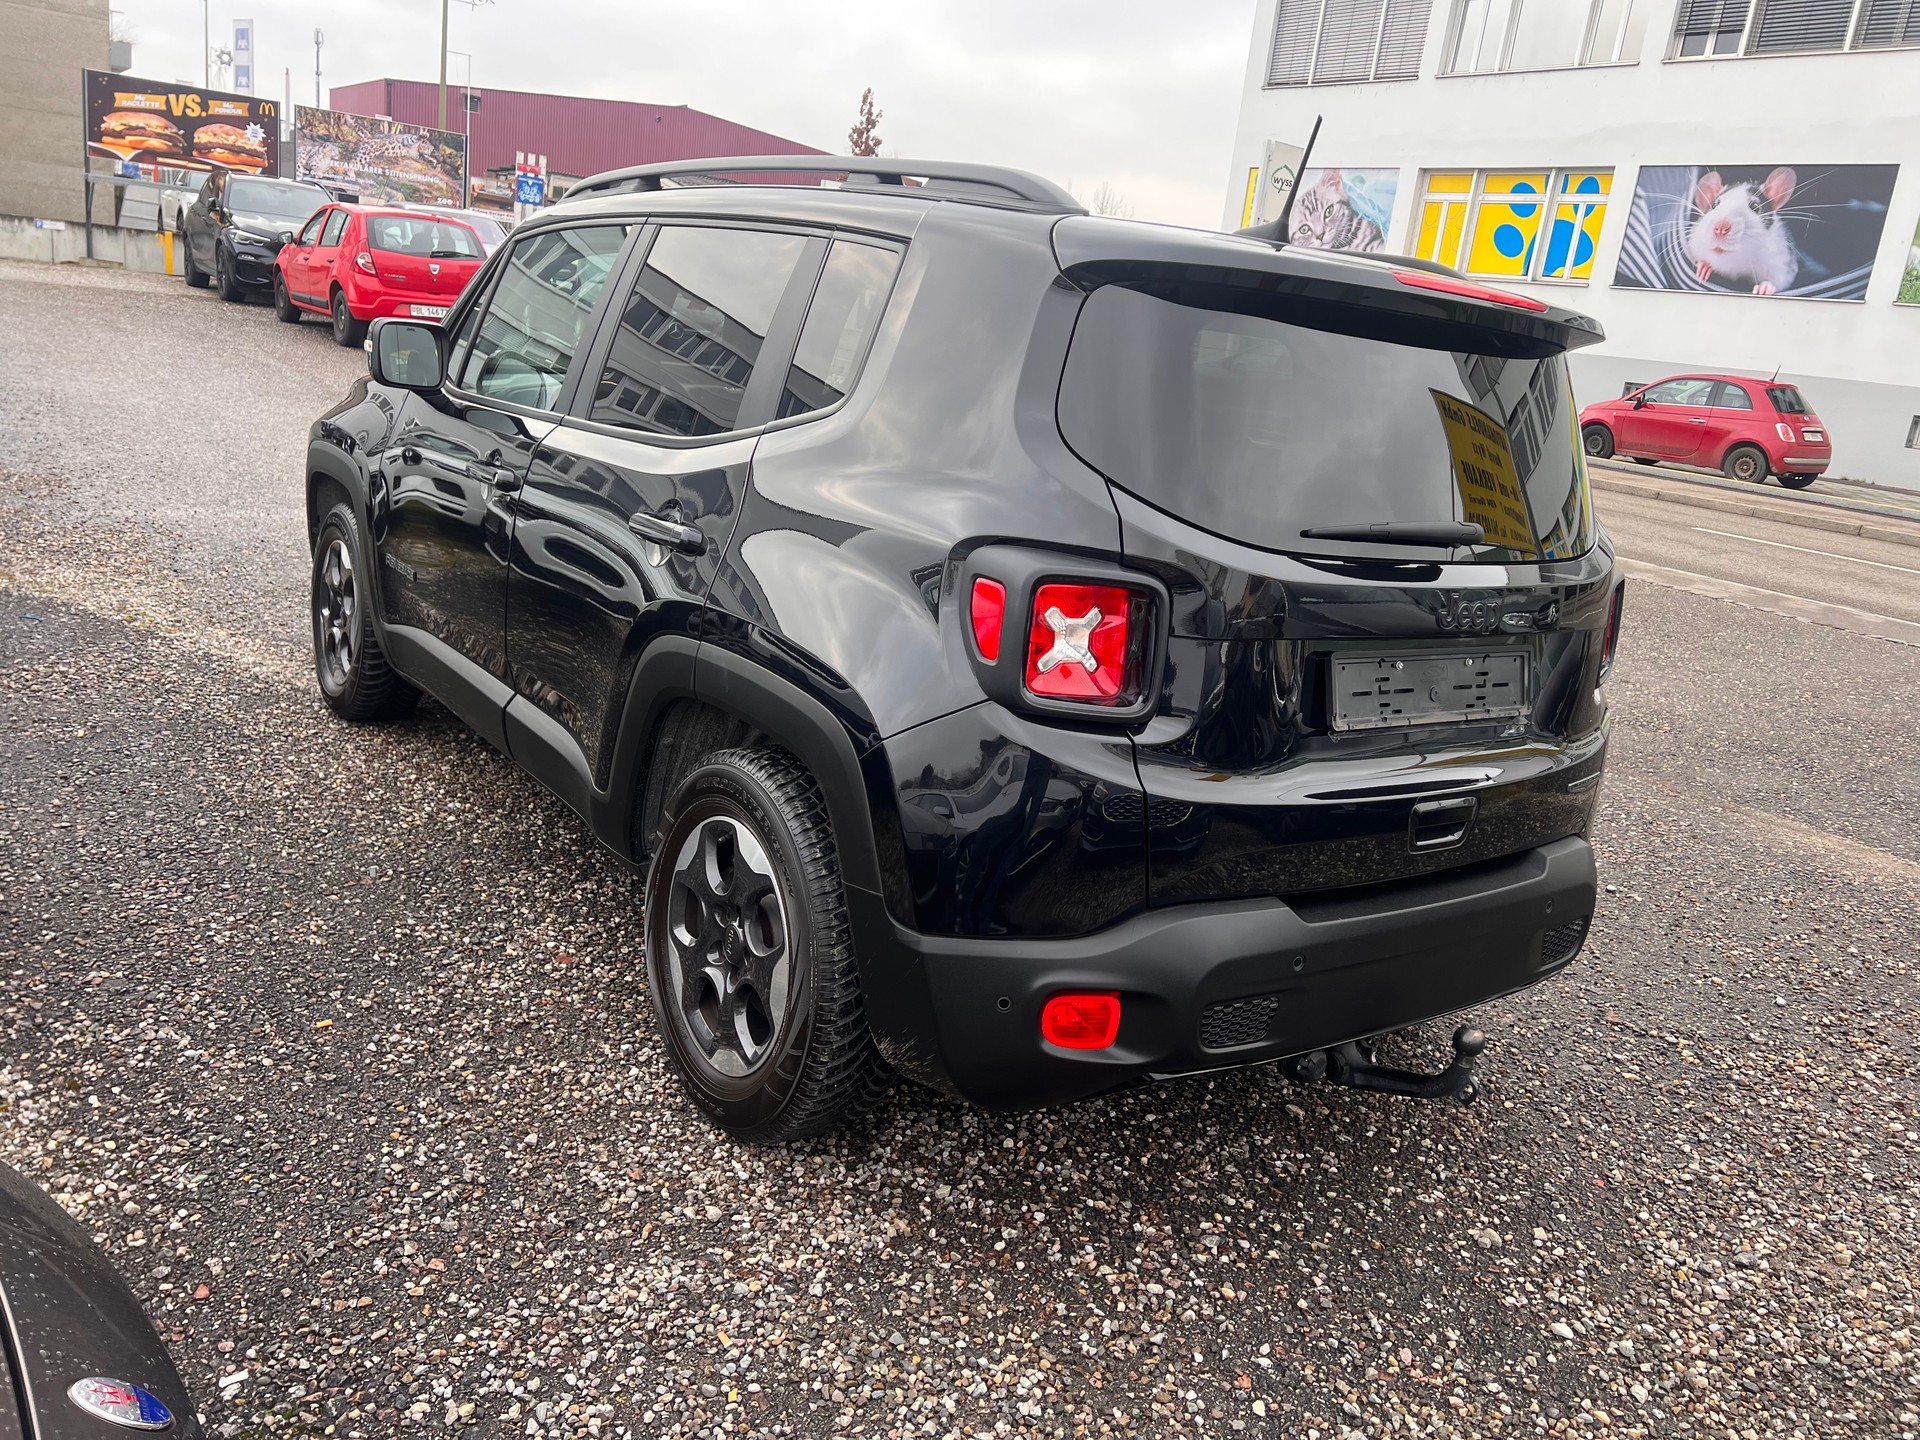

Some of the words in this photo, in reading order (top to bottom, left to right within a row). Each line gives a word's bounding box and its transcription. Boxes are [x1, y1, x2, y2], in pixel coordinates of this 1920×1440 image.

[122, 100, 160, 108] RACLETTE
[168, 94, 207, 117] VS.
[1437, 592, 1500, 635] Jeep
